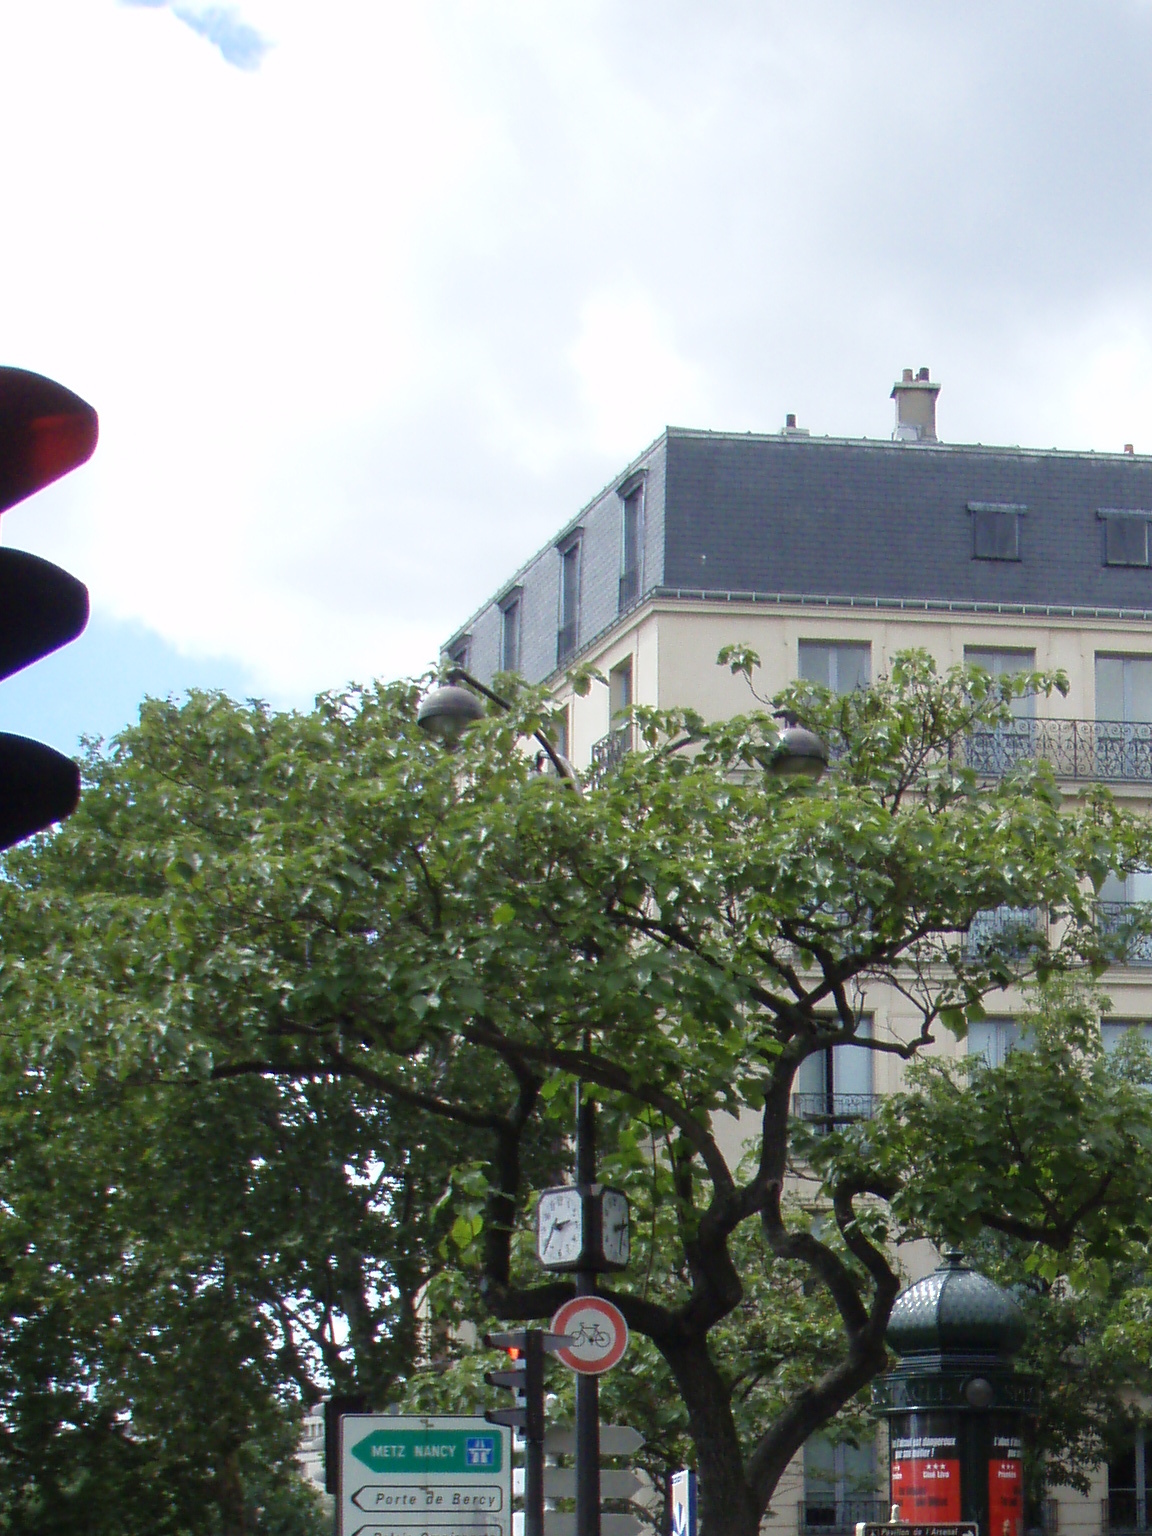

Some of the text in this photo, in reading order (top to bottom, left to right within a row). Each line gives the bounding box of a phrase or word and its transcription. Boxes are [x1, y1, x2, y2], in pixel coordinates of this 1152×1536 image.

[371, 1445, 456, 1457] METZ NANCY
[375, 1493, 495, 1507] Porte de Bercy
[881, 1527, 910, 1536] Pavillon
[913, 1527, 922, 1536] de
